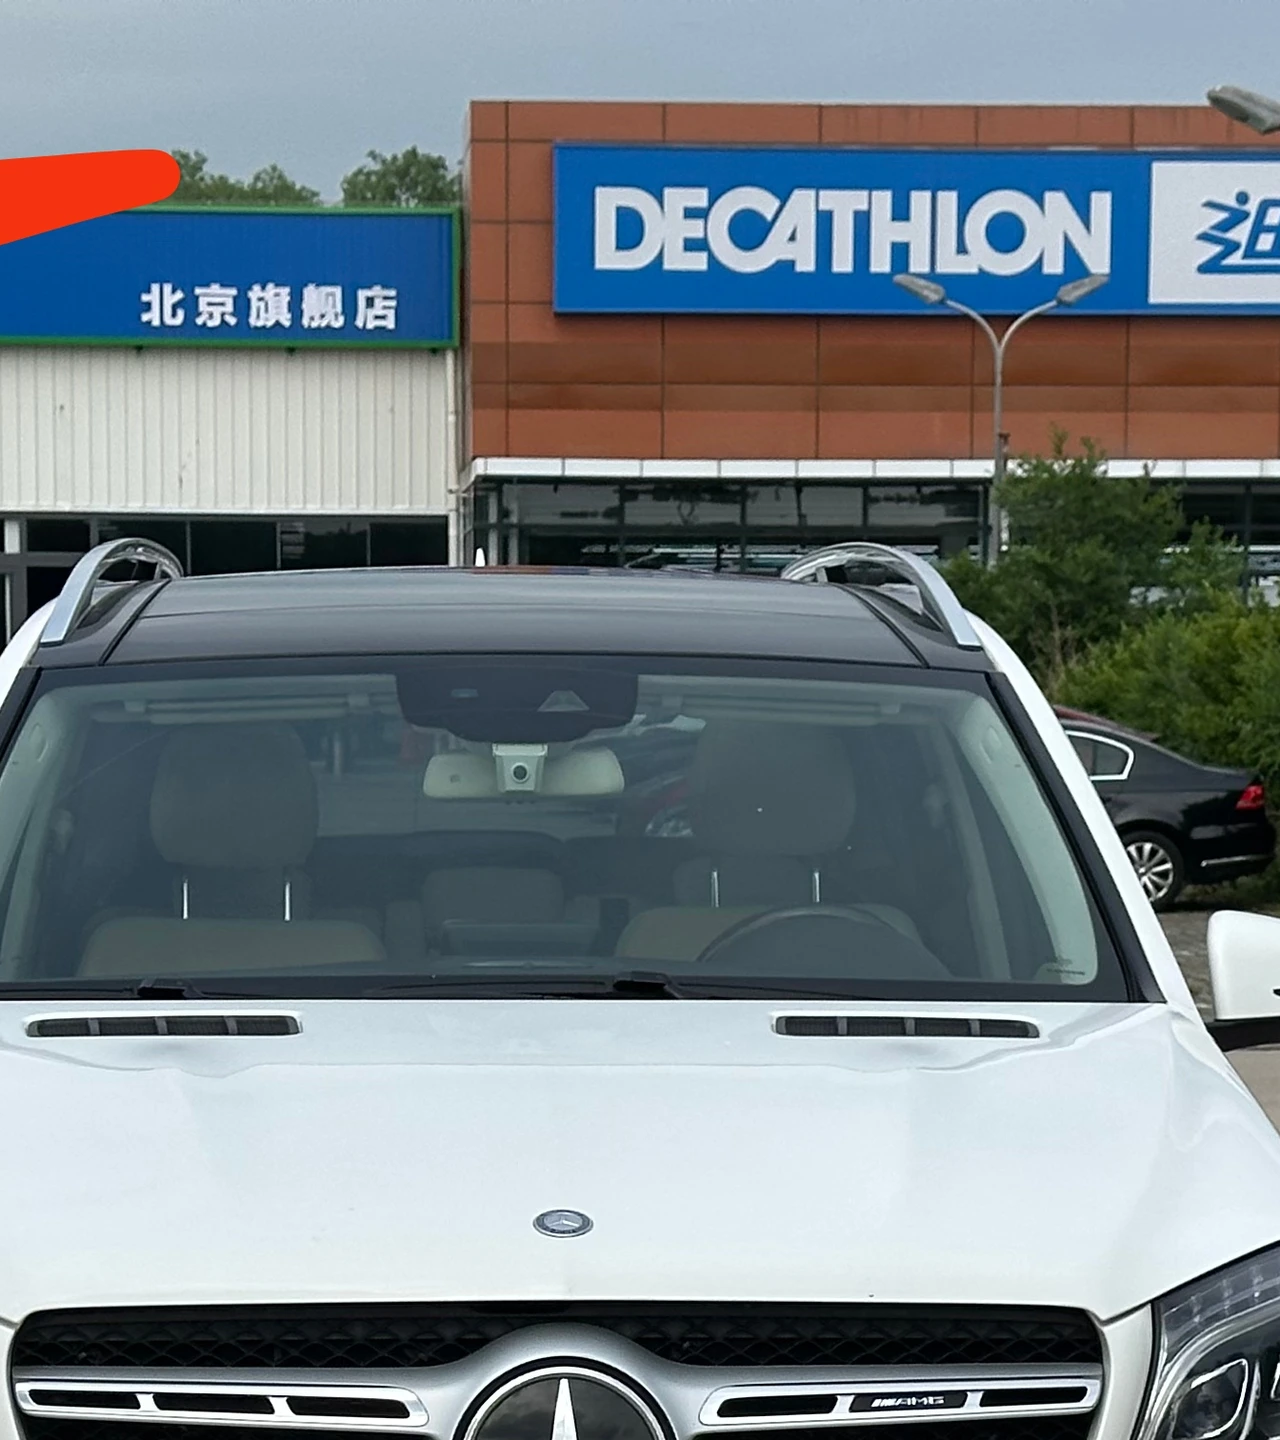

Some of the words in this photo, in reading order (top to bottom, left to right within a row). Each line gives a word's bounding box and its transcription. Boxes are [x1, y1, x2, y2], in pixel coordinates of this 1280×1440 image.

[593, 185, 1113, 276] DECATHLON
[140, 282, 398, 330] 北京旗舰店
